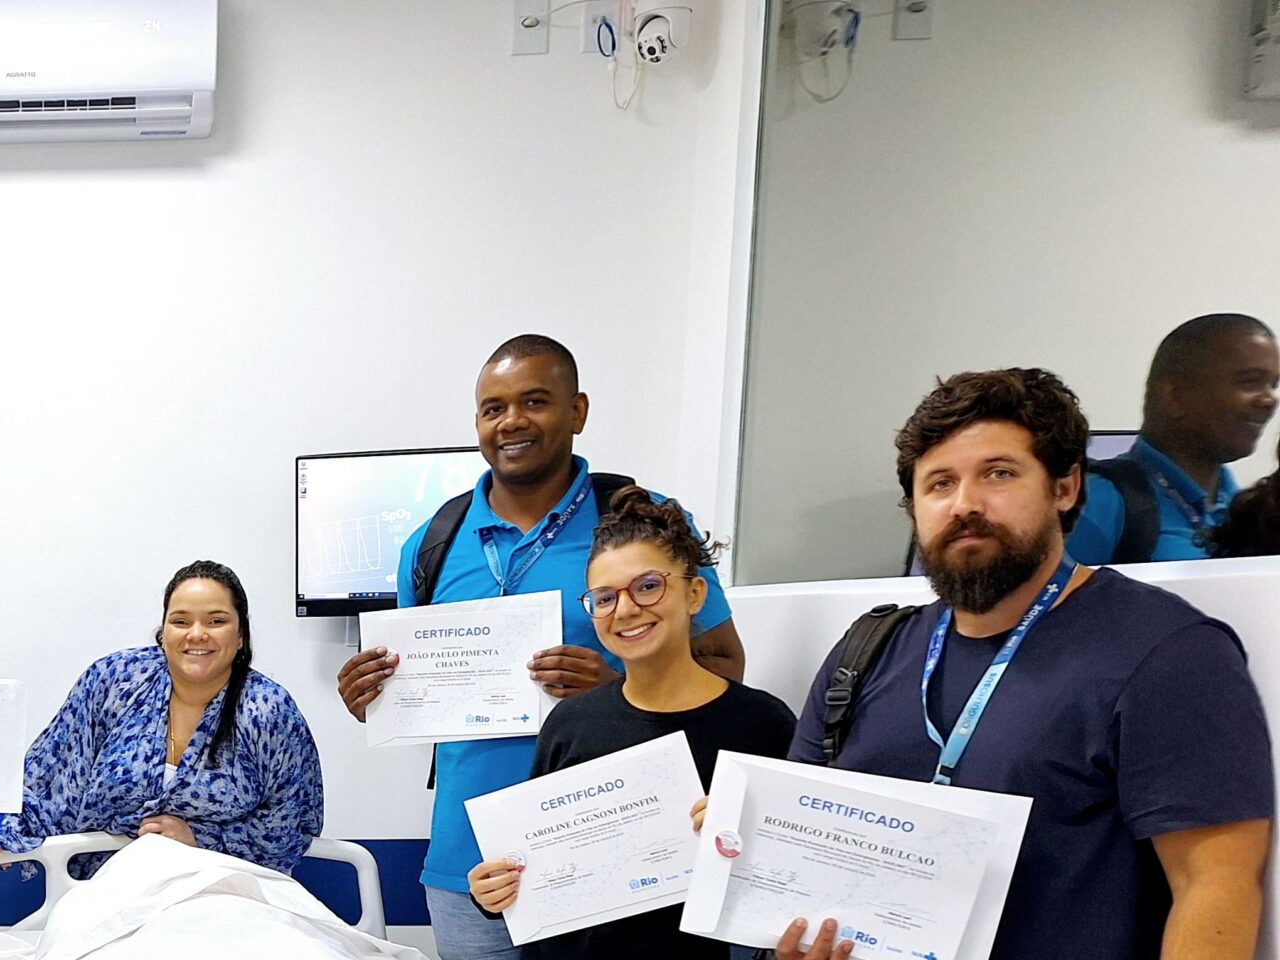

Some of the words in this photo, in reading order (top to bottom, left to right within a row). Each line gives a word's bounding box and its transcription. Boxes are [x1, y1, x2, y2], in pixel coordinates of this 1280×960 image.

[1017, 604, 1044, 632] SAÚDE
[414, 626, 490, 640] CERTIFICADO
[406, 651, 429, 660] JOÃO
[430, 650, 459, 660] PAULO
[460, 649, 500, 658] PIMENTA
[435, 660, 470, 668] CHAVES
[475, 715, 490, 724] Rio
[540, 778, 625, 812] CERTIFICADO
[525, 820, 572, 840] CAROLINE
[573, 807, 618, 828] CAGNONI
[619, 795, 659, 814] BONFIM
[798, 794, 915, 834] CERTIFICADO
[764, 816, 824, 840] RODRIGO
[825, 830, 878, 853] FRANCO
[640, 876, 658, 888] Rio
[855, 930, 878, 946] Rio
